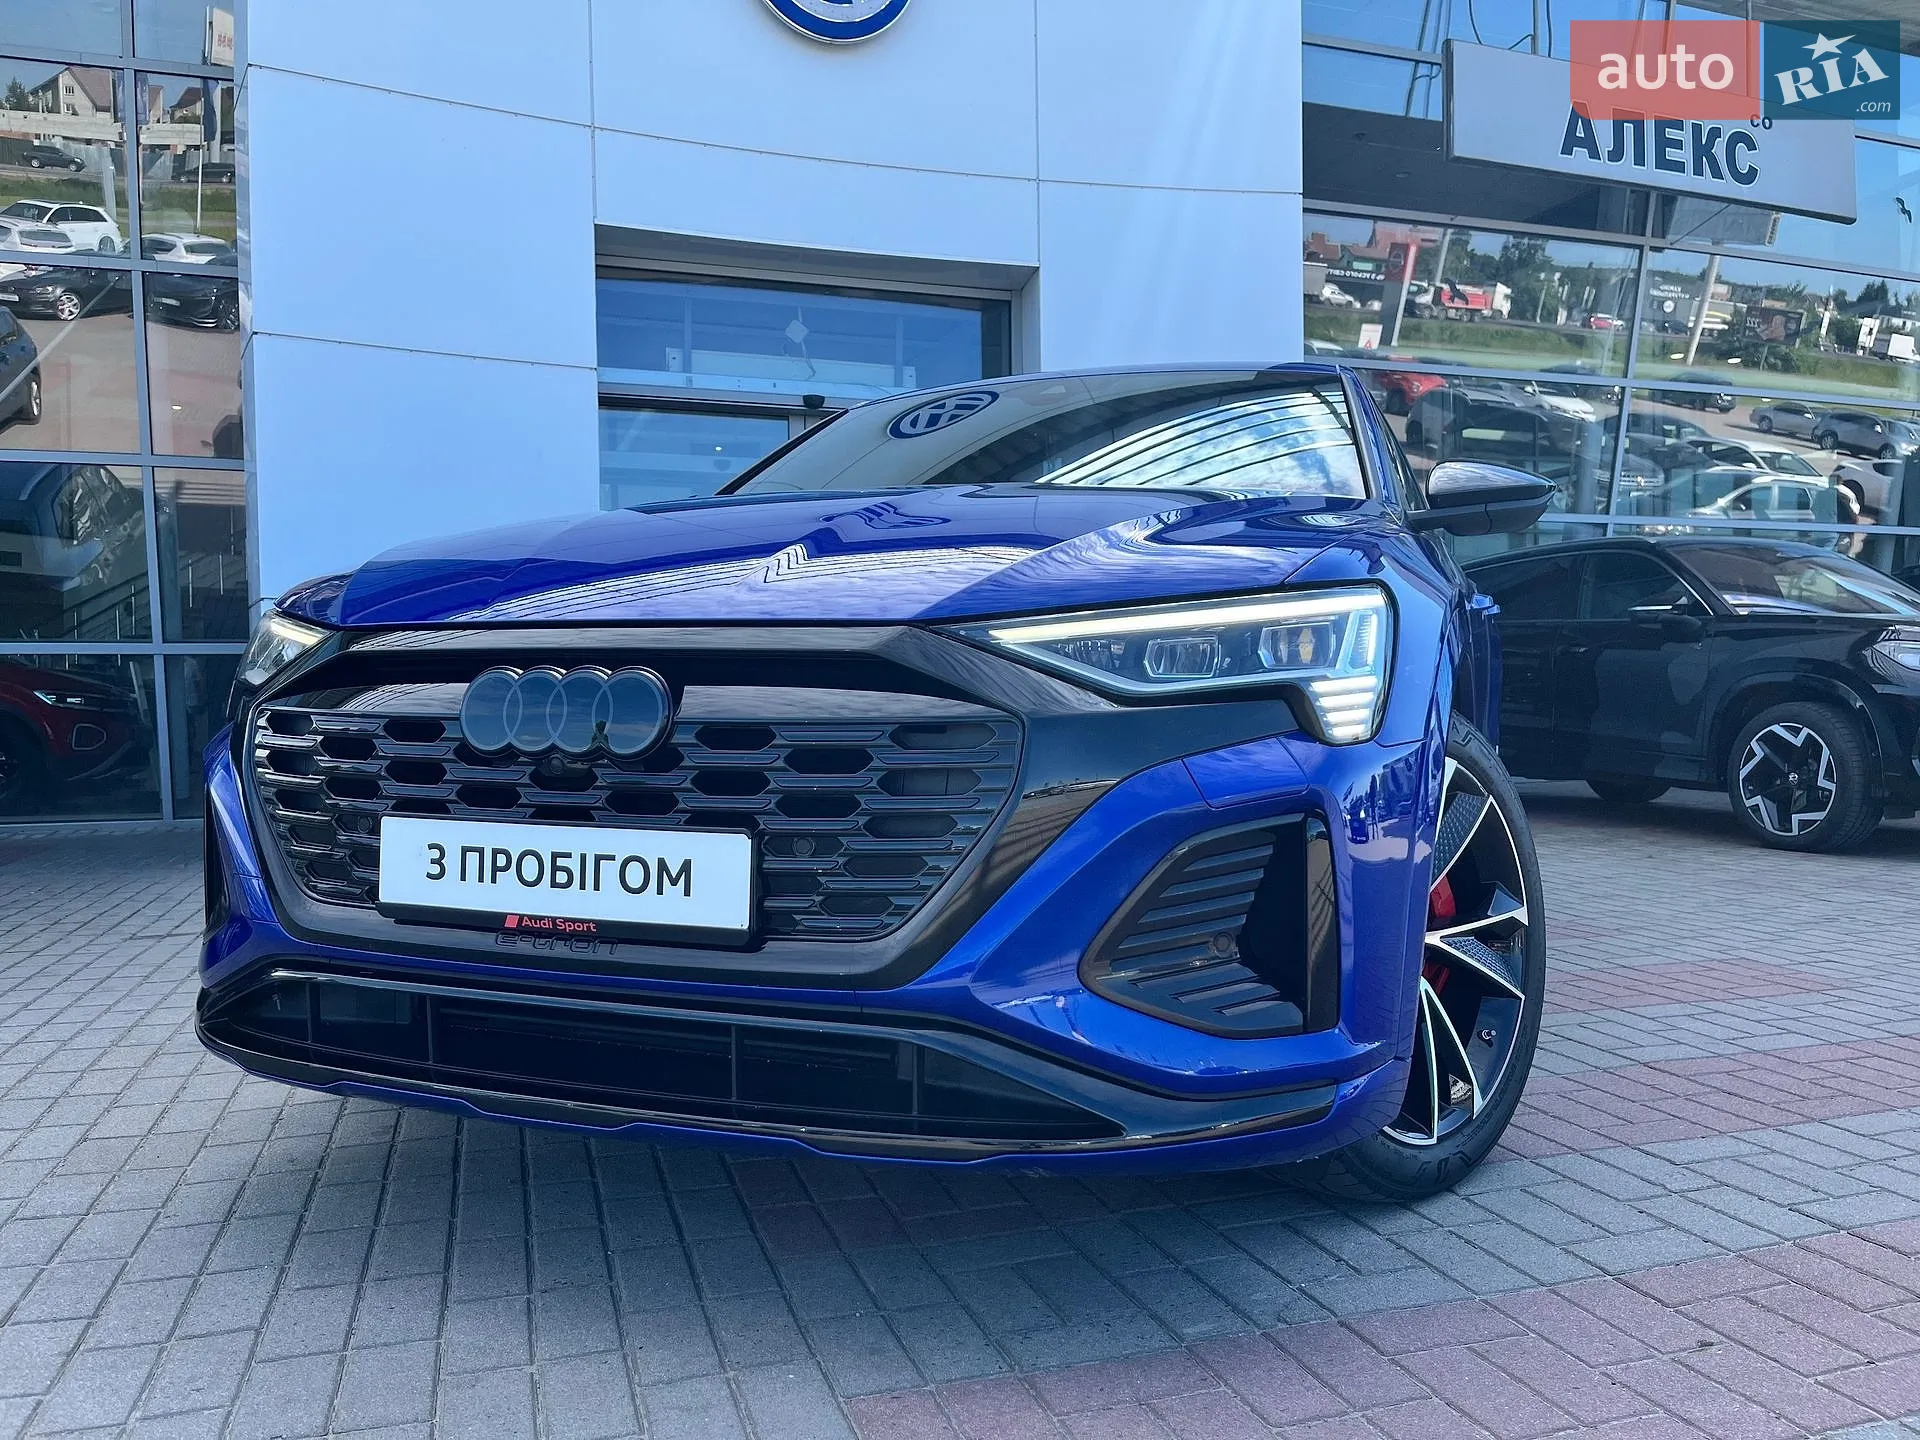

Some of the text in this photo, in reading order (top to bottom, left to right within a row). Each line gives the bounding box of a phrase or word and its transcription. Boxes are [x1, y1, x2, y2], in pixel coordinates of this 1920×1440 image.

[1560, 101, 1760, 187] АЛЕКС
[460, 845, 693, 898] ПРОБІГОМ
[521, 916, 597, 933] Audi Sport
